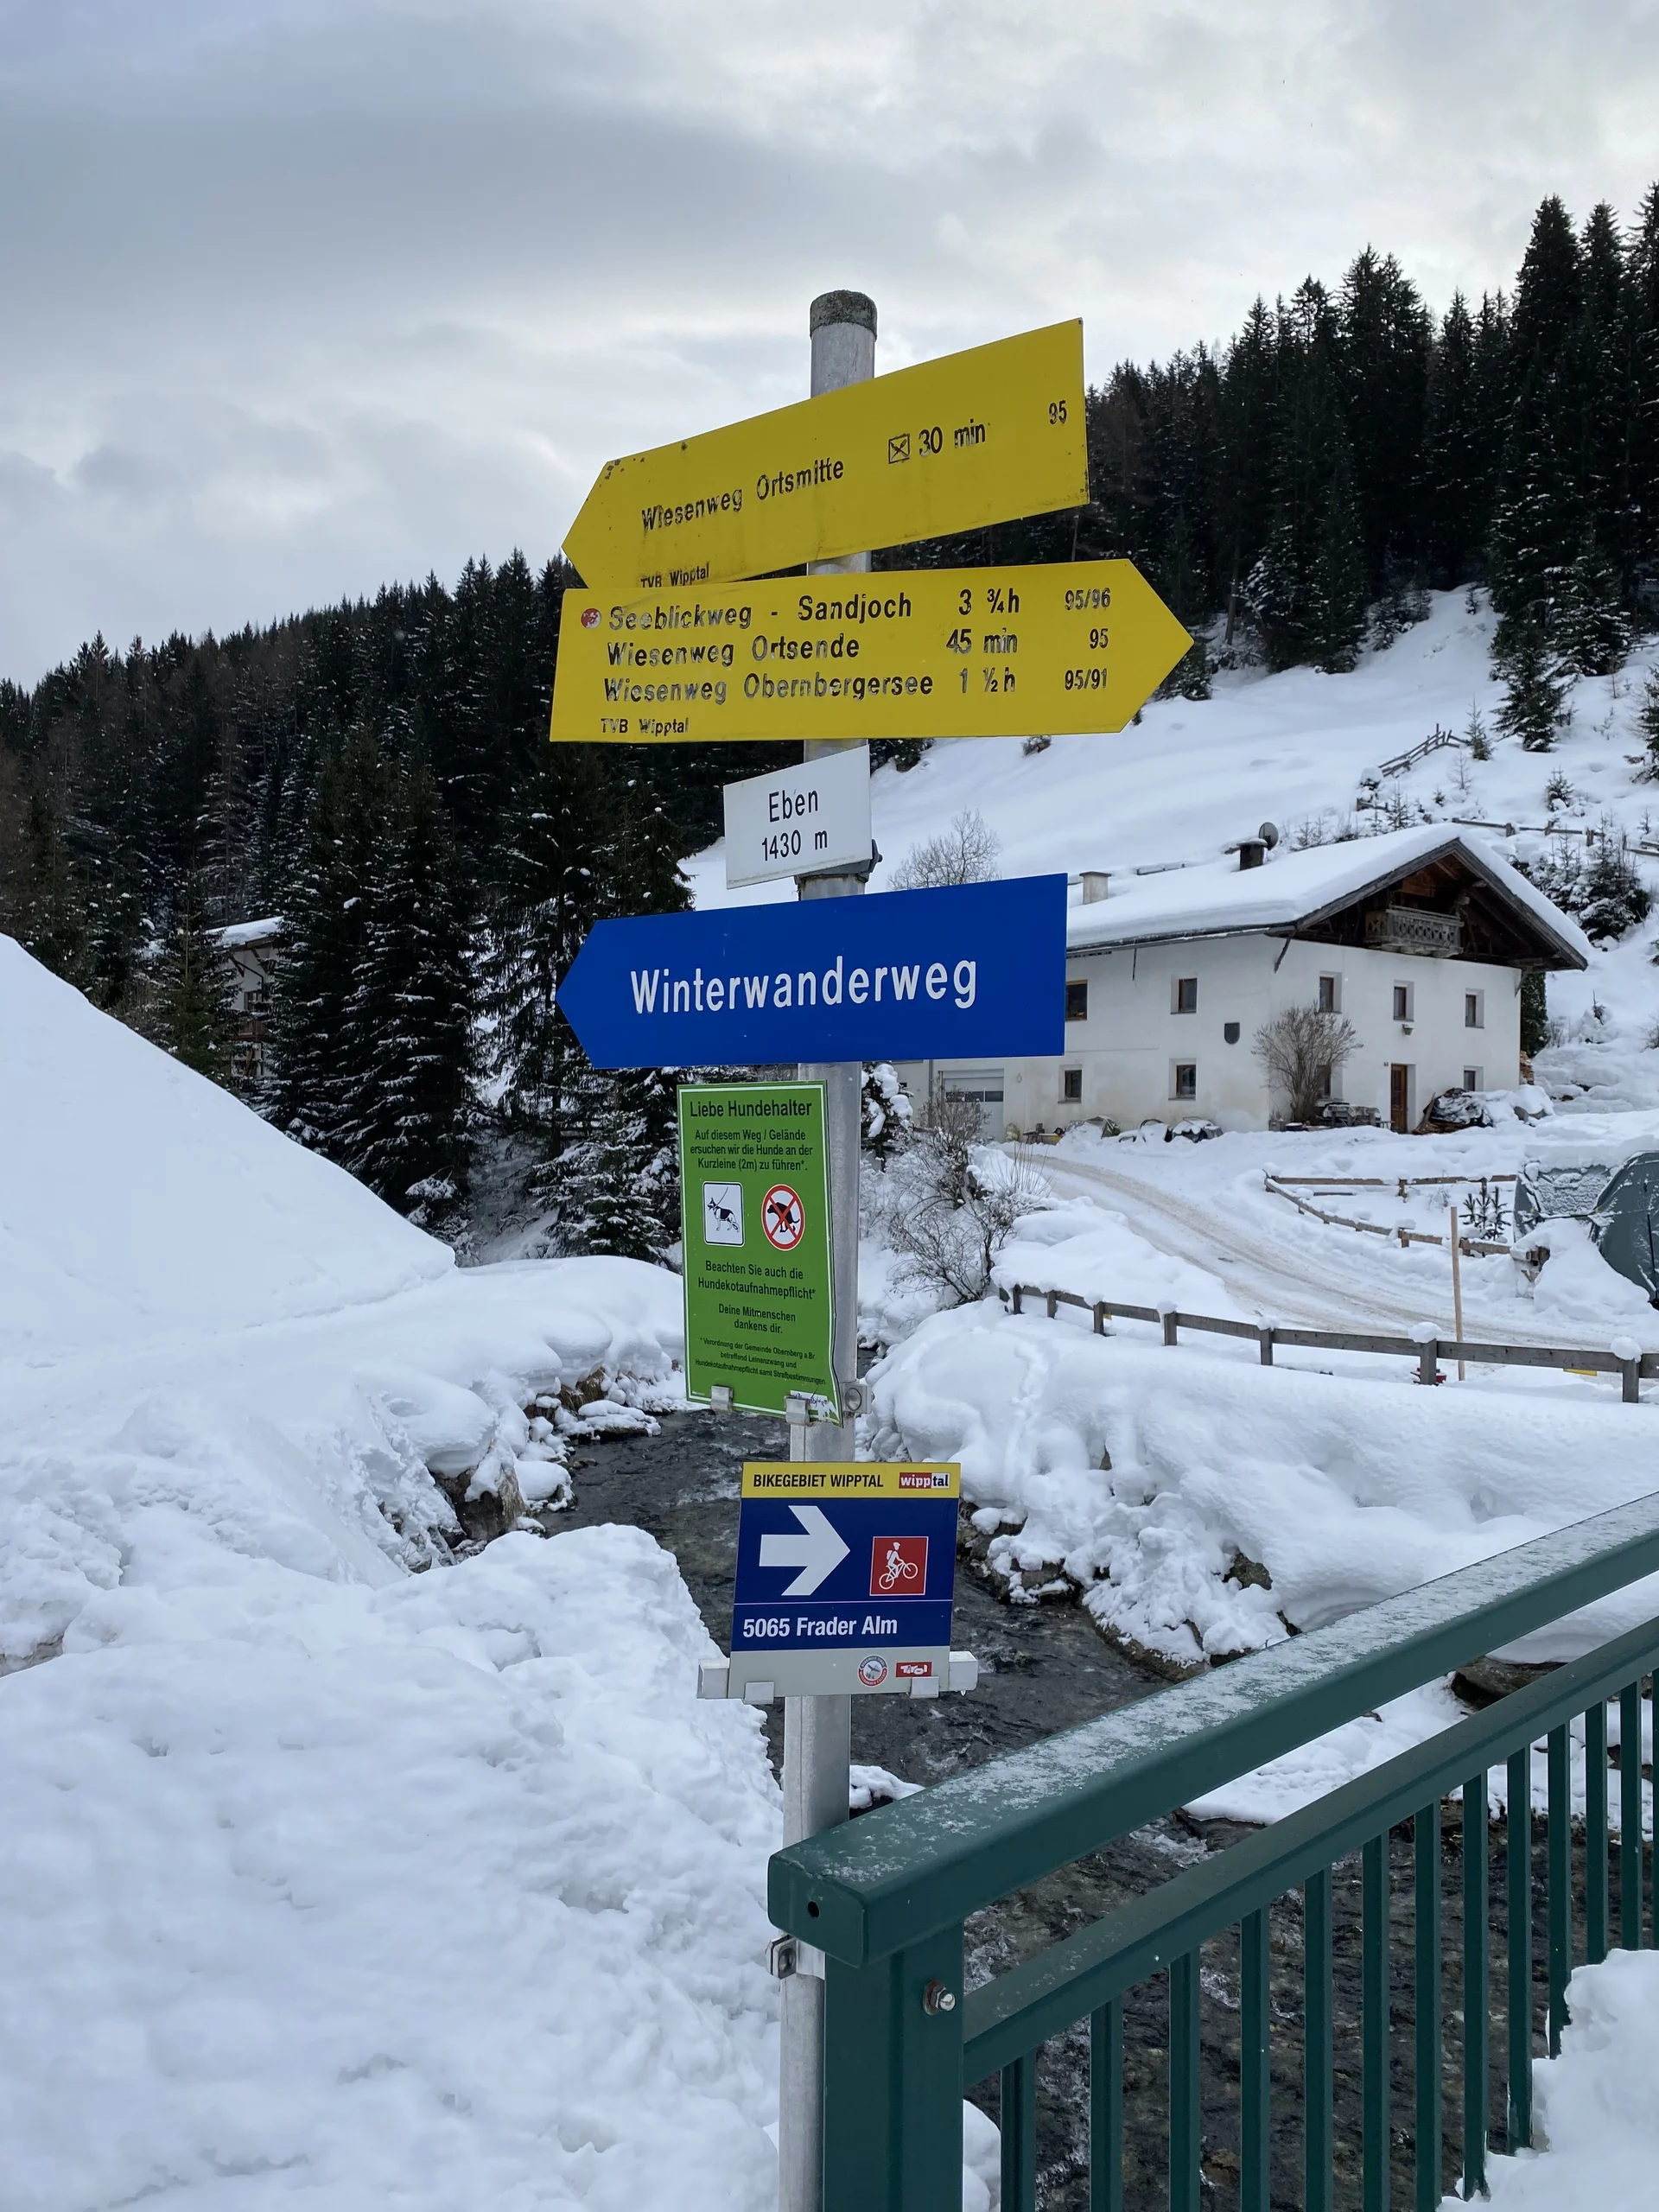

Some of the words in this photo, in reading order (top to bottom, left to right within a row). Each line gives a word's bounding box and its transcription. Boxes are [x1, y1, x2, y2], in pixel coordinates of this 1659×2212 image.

[641, 489, 742, 531] Wiesenweg
[757, 457, 844, 500] Ortsmitte
[918, 426, 943, 457] 30
[954, 418, 986, 448] min
[1048, 399, 1067, 425] 95
[640, 574, 662, 588] TVB
[670, 563, 709, 587] Wipptal
[609, 604, 752, 630] Seeblickweg
[798, 592, 912, 624] Sandjoch
[958, 588, 972, 615] 3
[1065, 588, 1111, 610] 95/96
[607, 642, 734, 667] Wiesenweg
[752, 632, 859, 661] Ortsende
[946, 629, 972, 654] 45
[983, 627, 1018, 653] min
[1090, 628, 1109, 649] 95
[604, 677, 727, 705] Wiesenweg
[744, 672, 933, 701] Obernbergersee
[959, 668, 968, 693] 1
[1065, 668, 1108, 690] 95/91
[601, 718, 628, 734] TVB
[639, 717, 690, 736] Wipptal
[769, 790, 818, 822] Eben
[761, 830, 801, 861] 1430
[815, 830, 828, 850] m
[630, 955, 978, 1014] Winterwanderweg
[690, 1101, 724, 1117] Liebe
[728, 1099, 812, 1116] Hundehalter
[695, 1129, 709, 1141] Auf
[711, 1130, 741, 1141] diesem
[742, 1129, 761, 1142] Weg
[769, 1128, 806, 1141] Gelände
[690, 1144, 726, 1154] ersuchen
[728, 1145, 741, 1155] wir
[742, 1144, 754, 1155] die
[756, 1145, 784, 1155] Hunde
[785, 1147, 797, 1155] an
[798, 1145, 813, 1156] der
[698, 1158, 736, 1170] Kurzleine
[739, 1159, 757, 1172] (2m)
[760, 1160, 770, 1170] zu
[705, 1260, 746, 1274] Beachten
[748, 1264, 762, 1276] Sie
[765, 1265, 787, 1278] auch
[789, 1268, 804, 1280] die
[718, 1303, 741, 1315] Deine
[742, 1306, 796, 1322] Mitmenschen
[734, 1319, 768, 1332] dankens
[769, 1322, 783, 1334] dir.
[703, 1338, 734, 1350] Verordnung
[745, 1343, 772, 1353] Gemeinde
[773, 1346, 803, 1359] Obernberg
[748, 1355, 785, 1368] Leinenzwang
[760, 1369, 772, 1377] samt
[753, 1473, 827, 1488] BIKEGEBIET
[830, 1474, 884, 1488] WIPPTAL
[900, 1473, 949, 1489] wipptal
[743, 1618, 791, 1637] 5065
[796, 1617, 856, 1637] Frader
[861, 1615, 898, 1635] Alm
